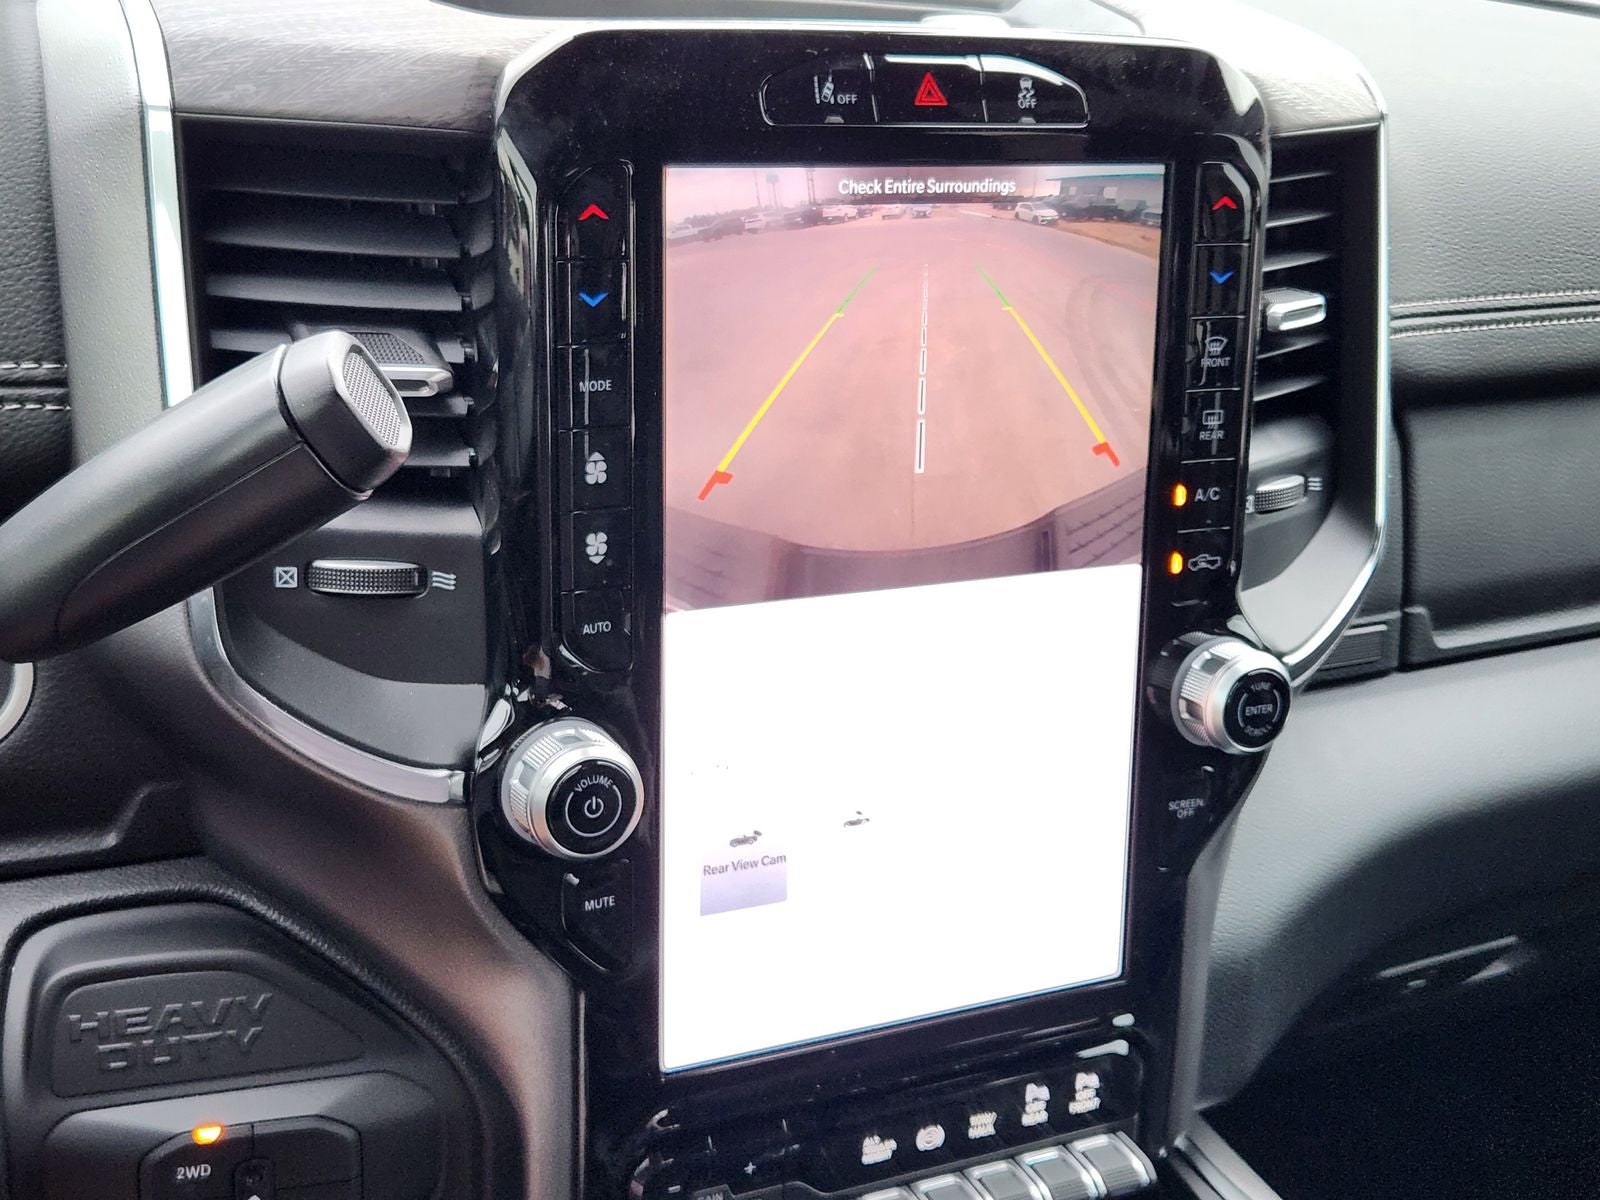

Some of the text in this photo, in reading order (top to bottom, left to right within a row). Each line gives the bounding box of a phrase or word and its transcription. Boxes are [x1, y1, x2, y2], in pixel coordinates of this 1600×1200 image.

[837, 94, 858, 105] OFF
[1018, 98, 1037, 110] OFF
[838, 177, 1017, 196] Check Entire Surroundings
[1200, 356, 1232, 368] FRONT
[579, 379, 613, 393] MODE
[1199, 429, 1225, 441] REAR
[1194, 487, 1221, 502] A/C
[582, 621, 612, 635] AUTO
[1245, 703, 1274, 716] ENTER
[574, 773, 615, 794] VOLUME
[1168, 797, 1204, 811] SCREEN
[703, 853, 787, 877] Rear View Cam
[584, 895, 616, 911] MUTE
[68, 992, 273, 1043] HEAVY
[176, 1163, 212, 1180] 2WD
